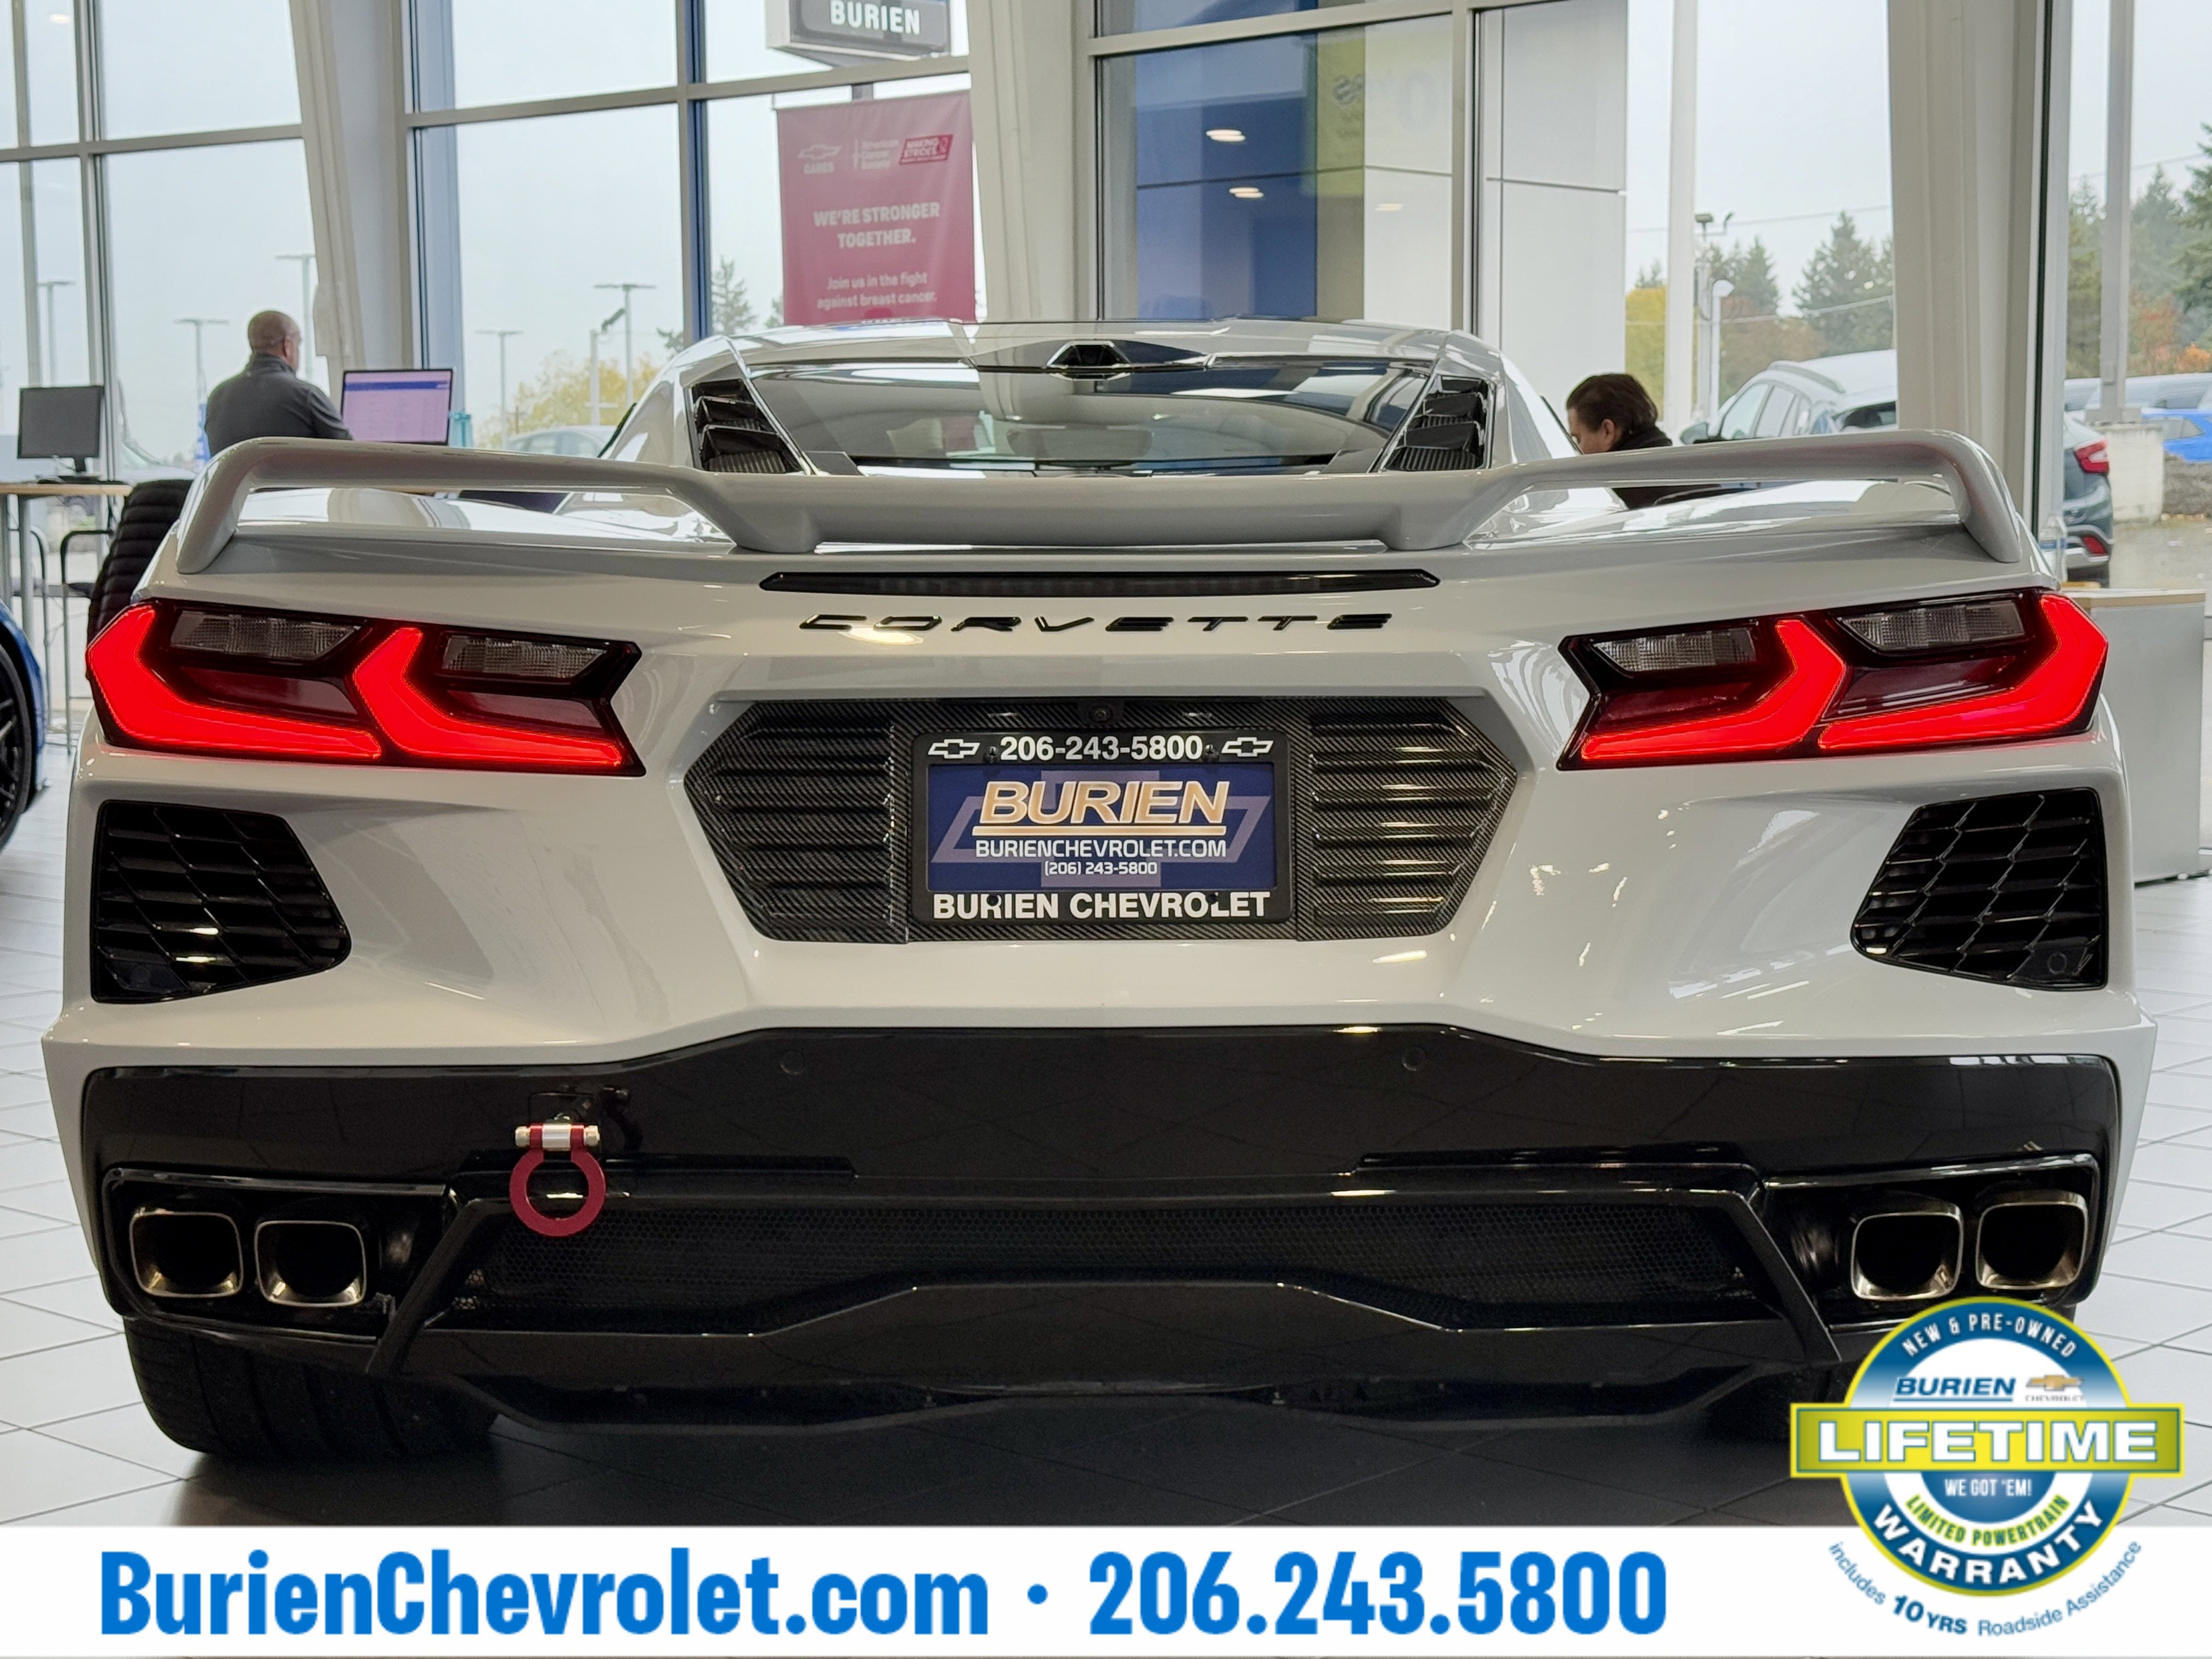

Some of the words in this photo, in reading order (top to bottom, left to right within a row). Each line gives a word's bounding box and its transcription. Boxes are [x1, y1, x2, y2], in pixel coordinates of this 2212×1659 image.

[830, 0, 920, 35] BURIEN
[813, 208, 860, 227] WE'RE
[862, 202, 940, 223] STRONGER
[837, 228, 917, 249] TOGETHER.
[827, 275, 849, 290] Join
[851, 278, 865, 288] us
[867, 275, 877, 287] in
[879, 274, 898, 286] the
[900, 272, 927, 287] fight
[816, 295, 858, 311] against
[859, 293, 896, 306] breast
[799, 613, 1392, 632] CORVETTE
[1000, 736, 1203, 760] 206-243-5800
[980, 781, 1230, 824] BURIEN
[975, 839, 1227, 859] BURIENCHEVROLET.COM
[1044, 861, 1082, 876] (206)
[1085, 861, 1158, 876] 243-5800
[933, 893, 1059, 919] BURIEN
[1069, 891, 1271, 919] CHEVROLET
